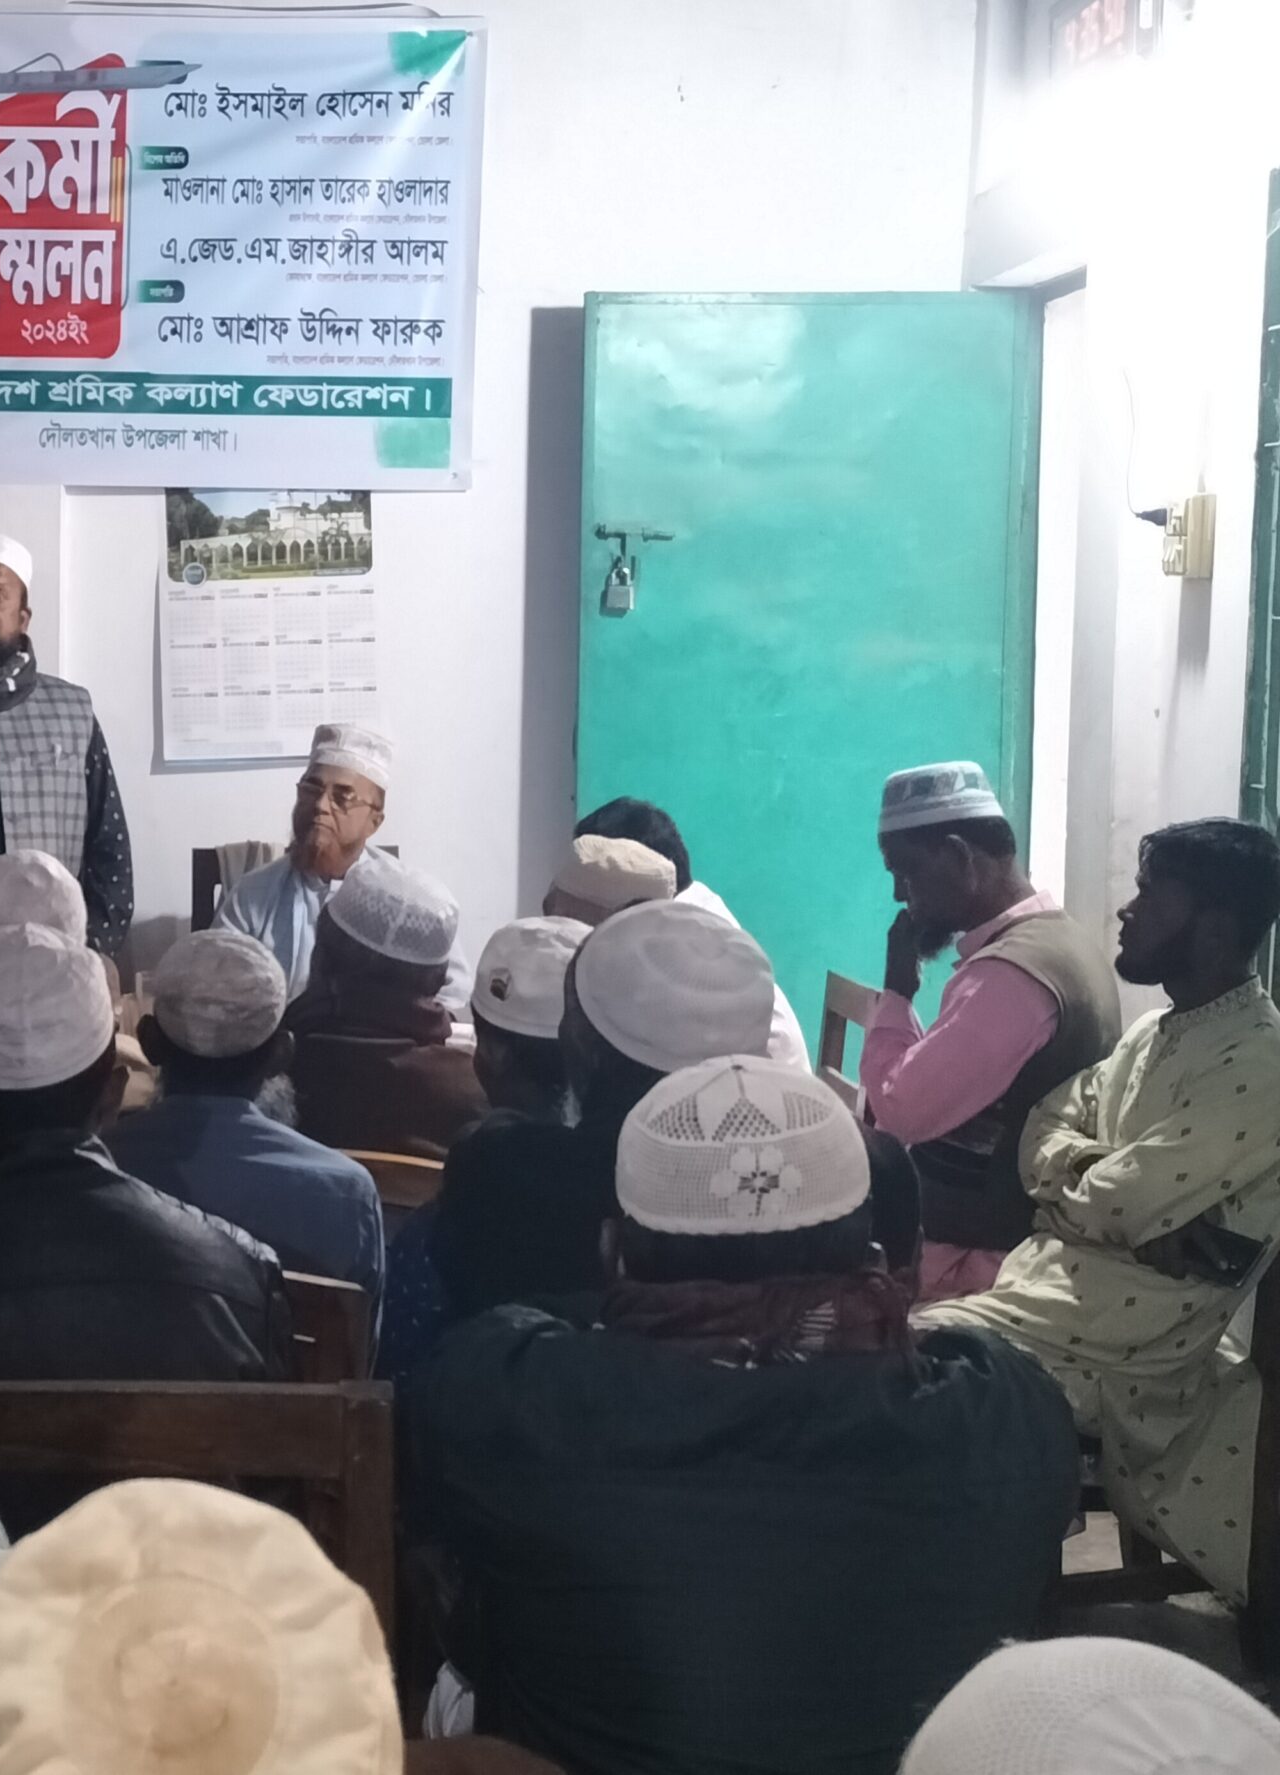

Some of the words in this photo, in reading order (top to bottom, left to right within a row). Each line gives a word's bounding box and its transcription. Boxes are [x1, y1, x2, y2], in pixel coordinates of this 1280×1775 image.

[164, 89, 207, 118] মোঃ
[214, 82, 308, 121] ইসমাইল
[316, 89, 393, 121] হোসেন
[162, 174, 227, 205] মাওলানা
[232, 175, 263, 204] মোঃ
[269, 175, 315, 207] হাসান
[319, 175, 371, 205] তারেক
[376, 176, 451, 209] হাওলাদার
[383, 236, 448, 266] আলম
[21, 312, 89, 345] ২০২৪ইং
[158, 313, 203, 343] মোঃ
[212, 313, 291, 345] আশ্রাফ
[298, 307, 363, 346] উদ্দিন
[369, 315, 446, 346] ফারুক
[48, 373, 137, 407] শ্রমিক
[144, 380, 244, 409] কল্যাণ
[253, 381, 414, 411] ফেডারেশন
[39, 419, 117, 450] দৌলতখান
[121, 421, 187, 450] উপজেলা
